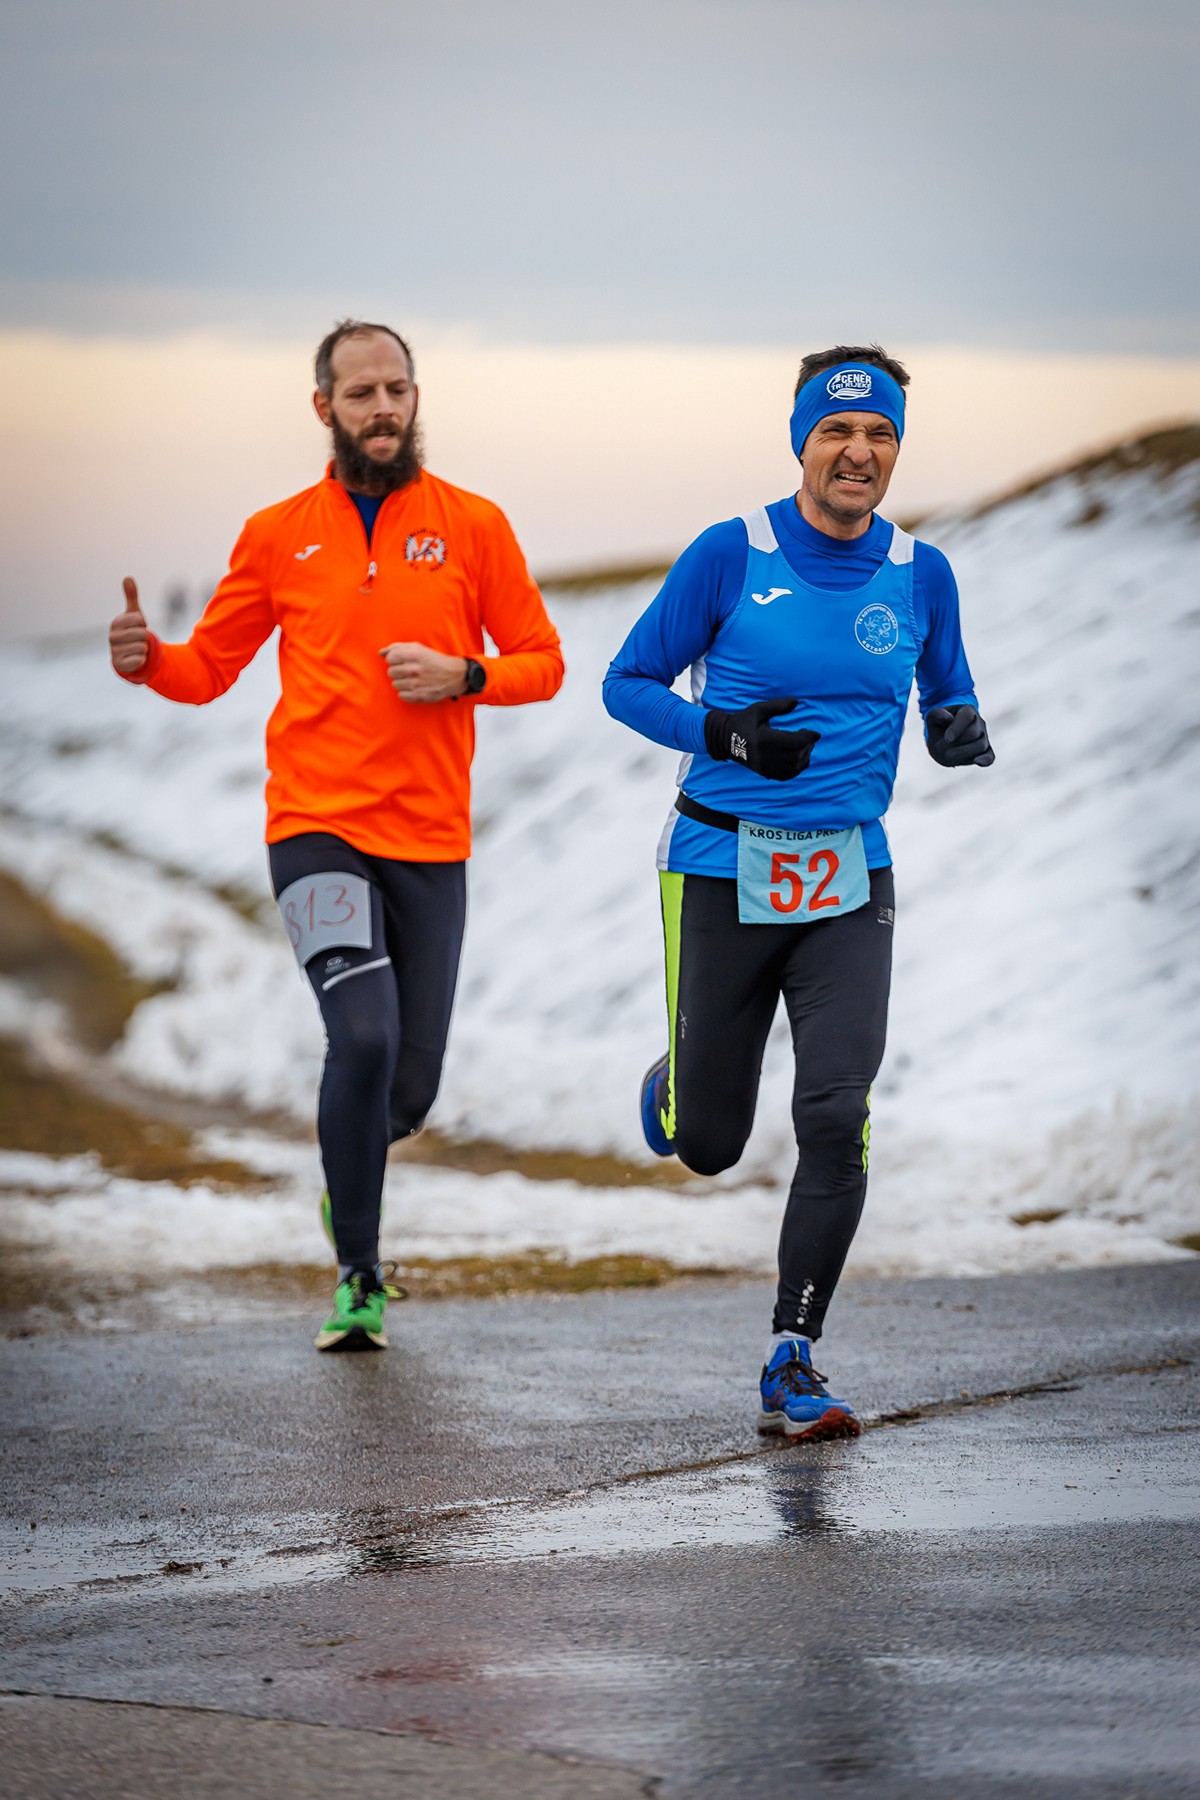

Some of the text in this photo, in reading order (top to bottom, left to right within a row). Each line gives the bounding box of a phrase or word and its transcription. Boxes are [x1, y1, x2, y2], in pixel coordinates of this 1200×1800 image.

[841, 373, 871, 384] CENER
[749, 827, 783, 840] KROS
[786, 831, 812, 840] LIGA
[769, 849, 840, 914] 52
[285, 884, 356, 949] 813
